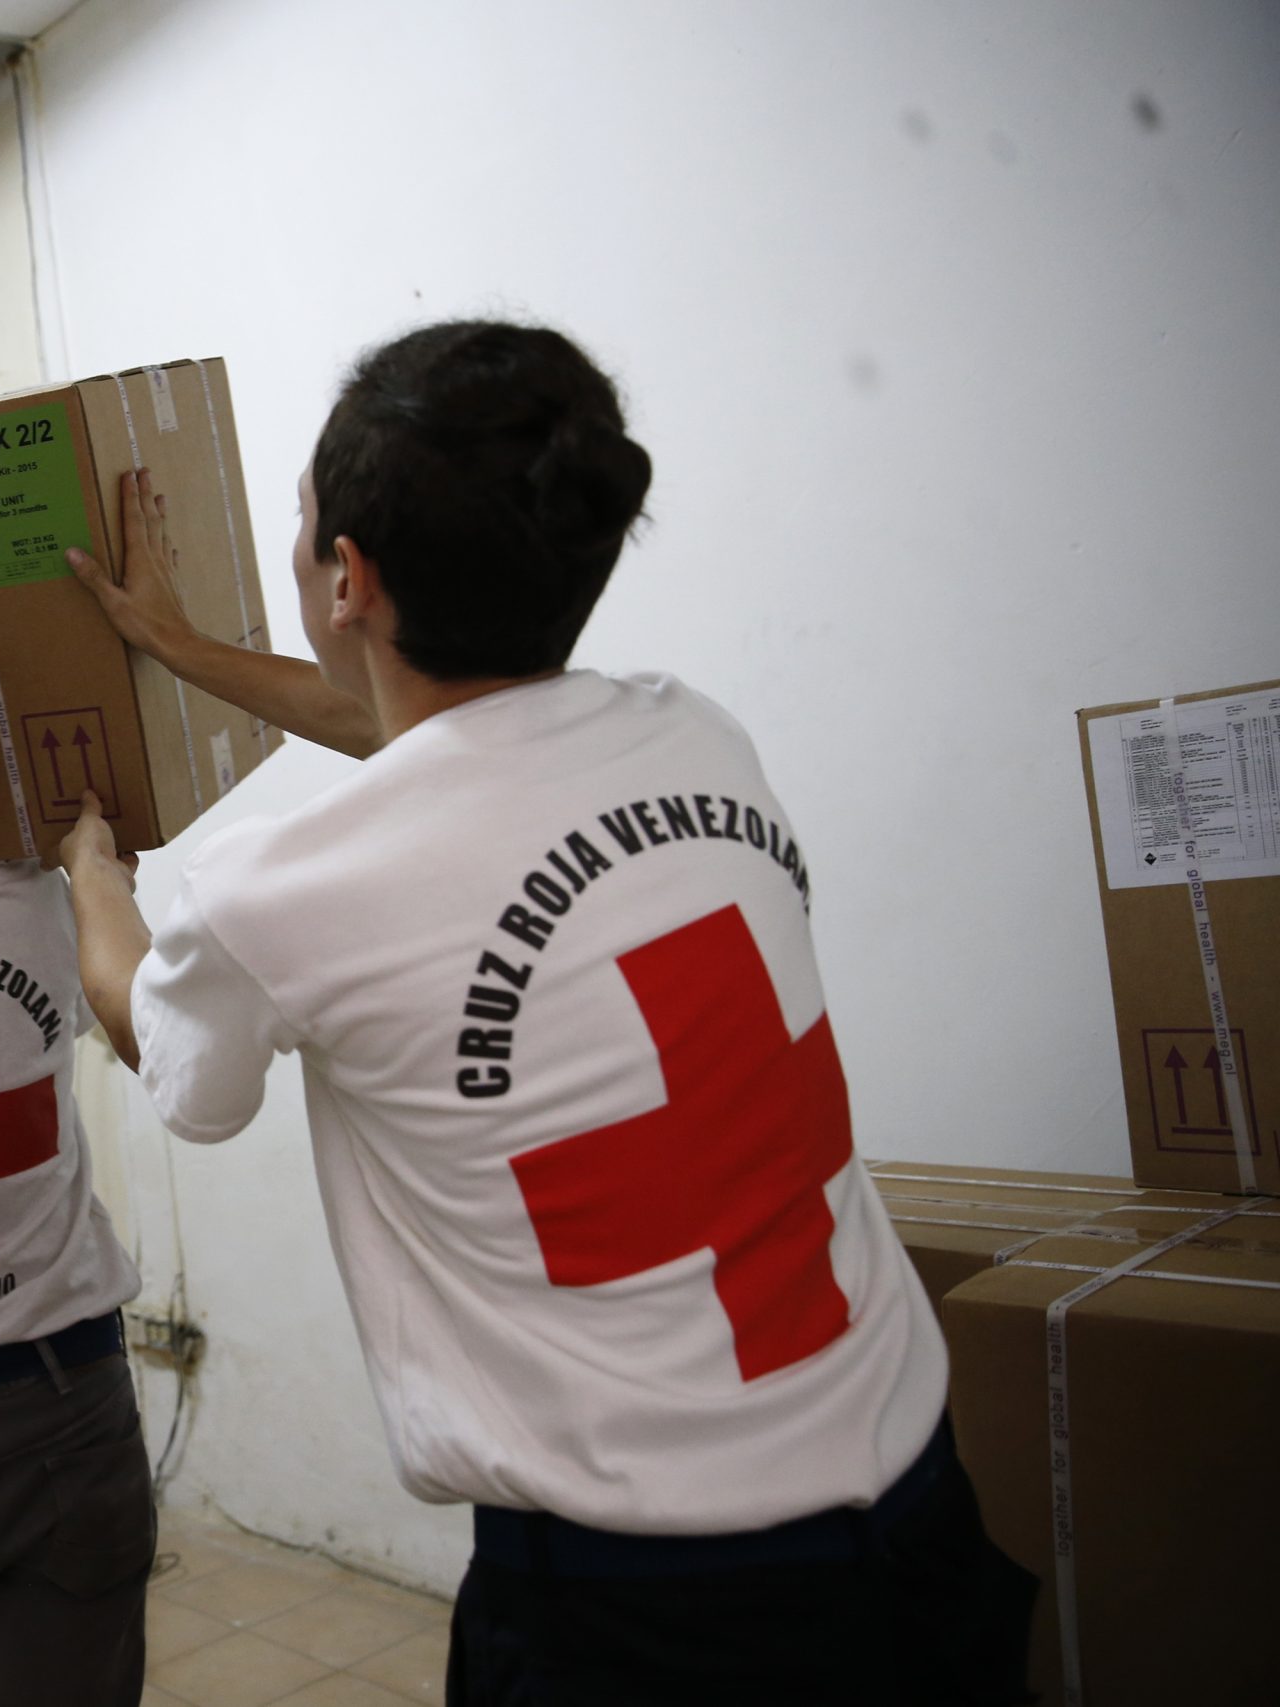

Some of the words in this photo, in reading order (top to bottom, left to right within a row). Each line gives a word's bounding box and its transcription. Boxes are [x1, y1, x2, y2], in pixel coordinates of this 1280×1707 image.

[16, 419, 54, 447] 2/2
[18, 461, 38, 473] 2015
[0, 510, 10, 518] for
[12, 508, 17, 516] 3
[19, 504, 48, 514] months
[1, 494, 25, 507] UNIT
[5, 747, 20, 785] health
[1173, 772, 1191, 830] together
[1184, 840, 1197, 859] for
[1186, 869, 1208, 912] global
[456, 949, 534, 1100] CRUZ
[497, 829, 614, 952] ROJA
[1199, 922, 1216, 966] health
[1211, 991, 1237, 1075] www.meg.nl
[1047, 1322, 1063, 1375] health
[1049, 1386, 1068, 1440] global
[1052, 1450, 1067, 1475] for
[1054, 1485, 1073, 1559] together
